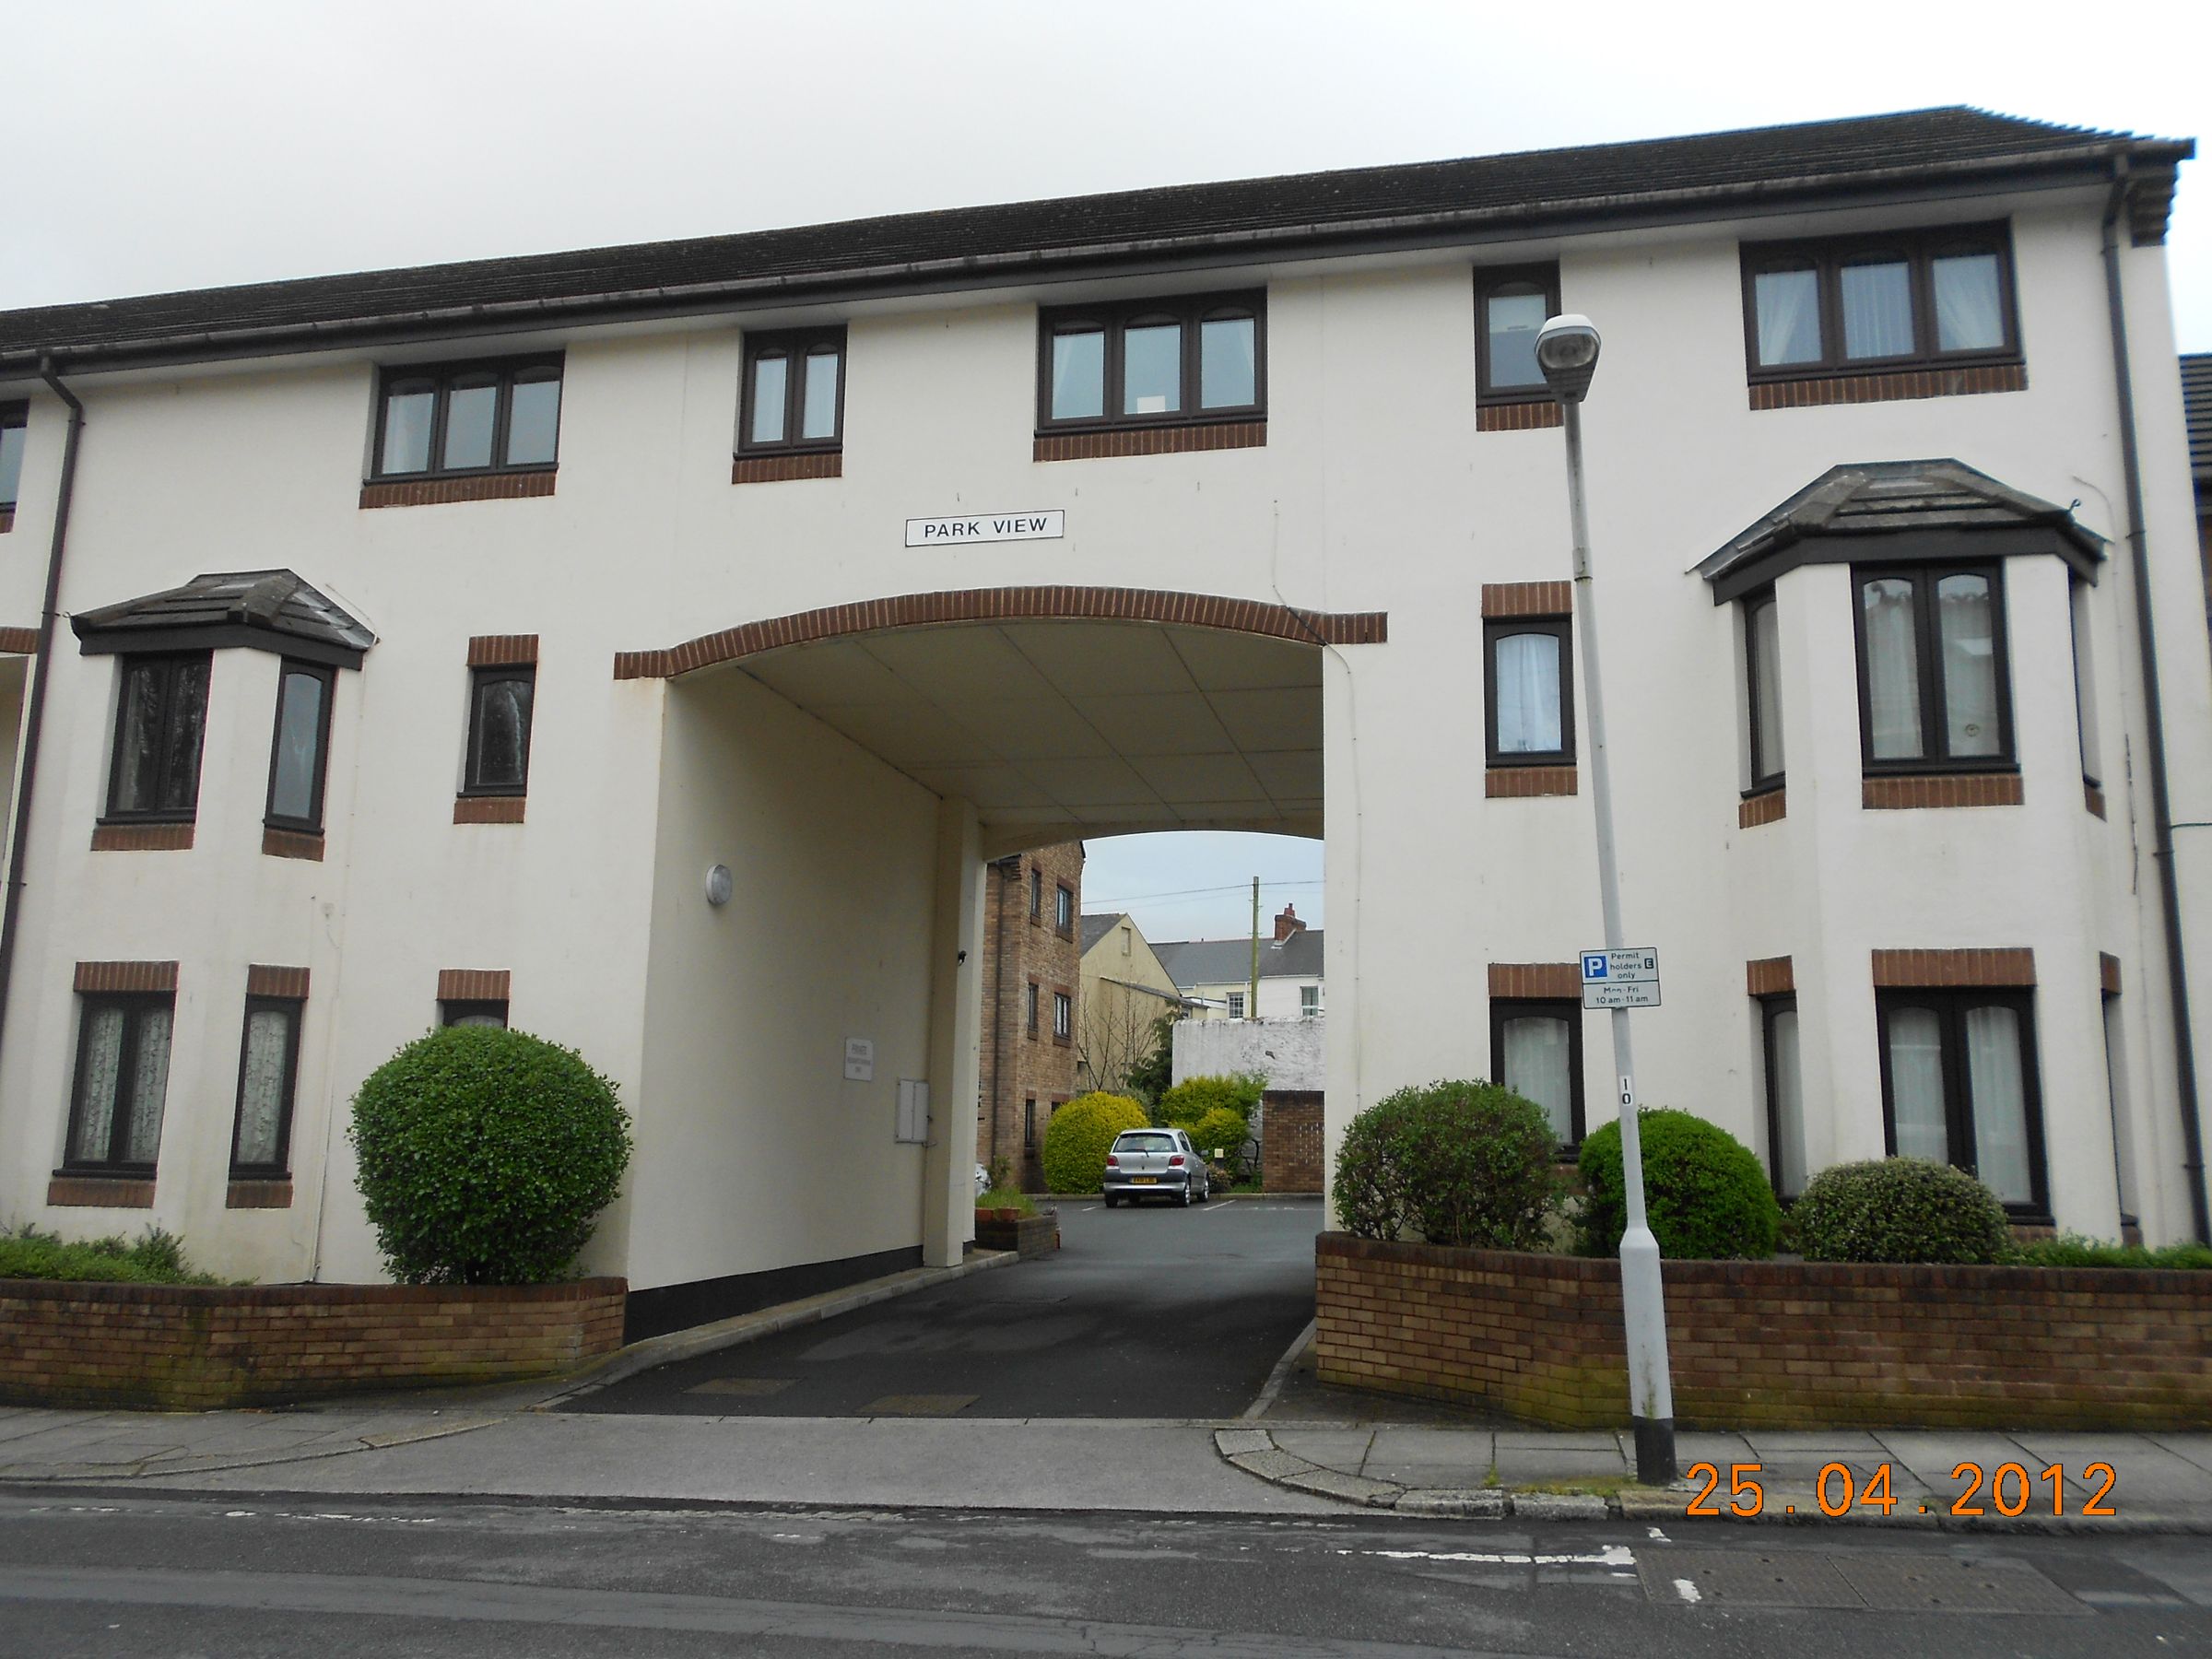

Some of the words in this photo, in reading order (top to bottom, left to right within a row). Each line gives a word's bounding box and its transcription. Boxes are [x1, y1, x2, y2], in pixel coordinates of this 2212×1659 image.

[924, 521, 980, 537] PARK
[994, 518, 1047, 534] VIEW
[1611, 951, 1639, 959] Permit
[1588, 958, 1603, 976] P
[1610, 962, 1641, 971] holders
[1645, 959, 1653, 969] E
[1618, 971, 1635, 979] only
